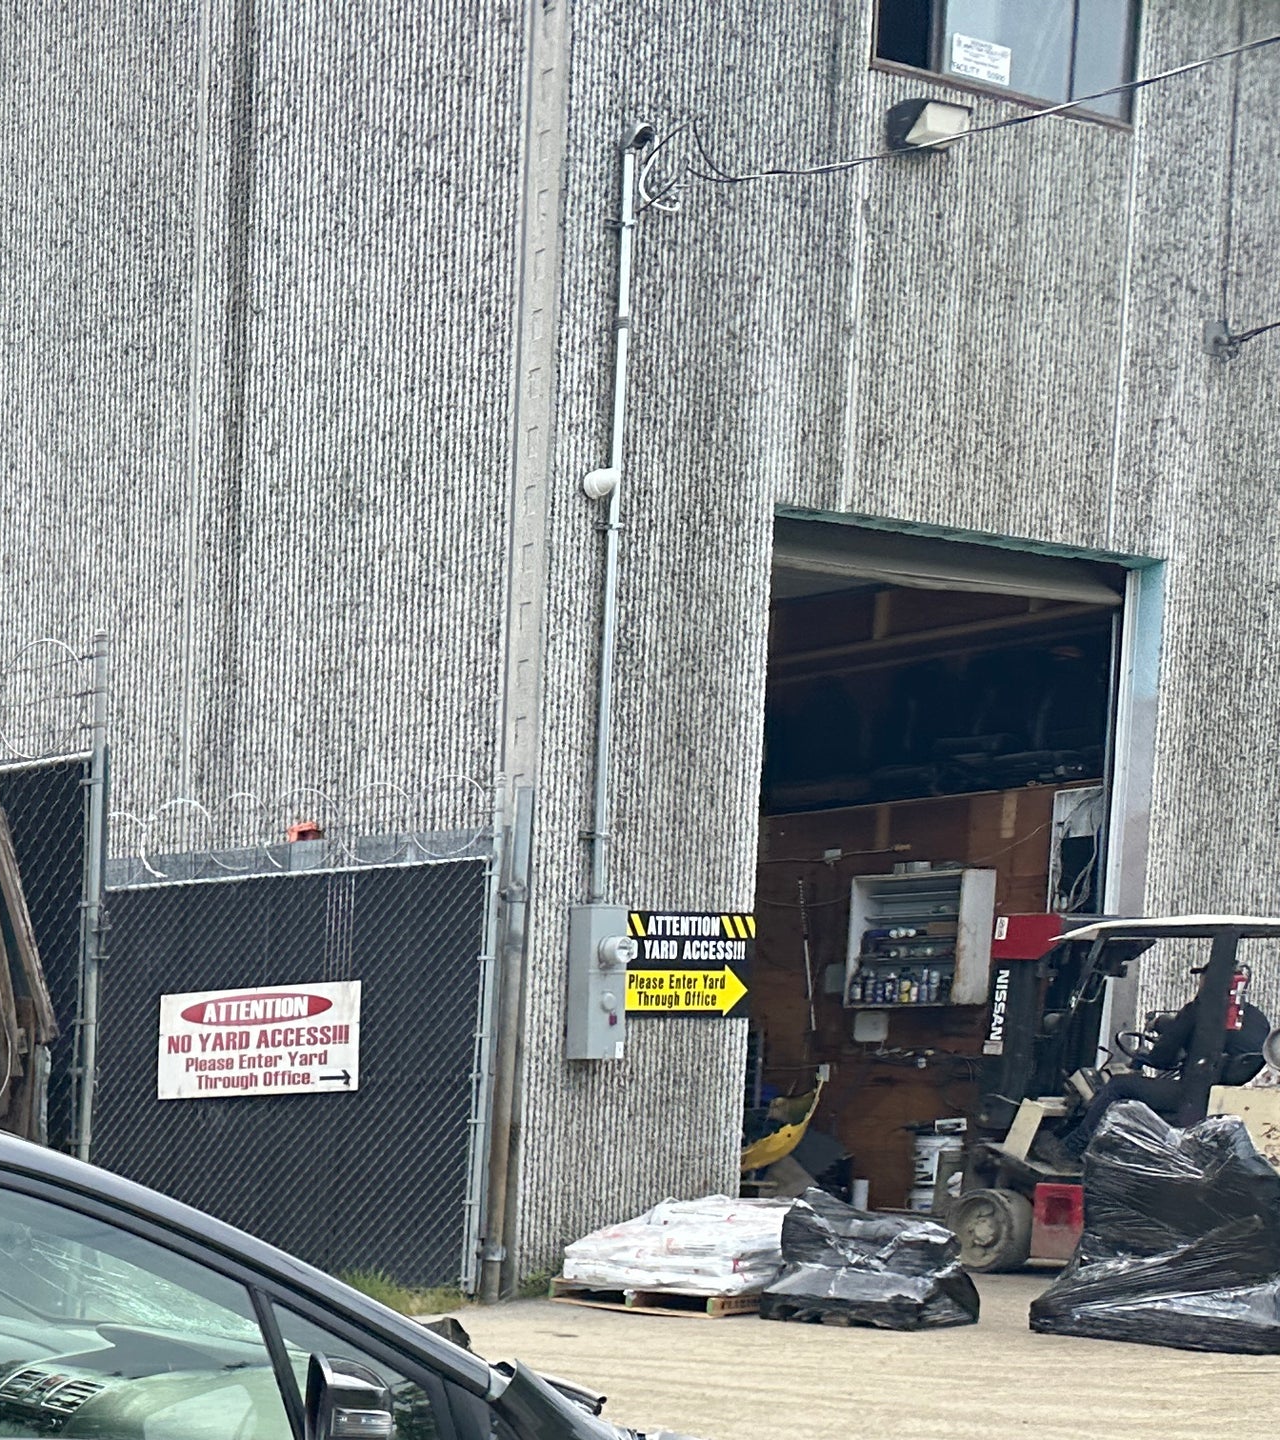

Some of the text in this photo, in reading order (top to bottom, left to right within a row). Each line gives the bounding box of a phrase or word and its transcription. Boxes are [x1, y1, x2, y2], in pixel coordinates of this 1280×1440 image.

[647, 915, 720, 937] ATTENTION
[644, 940, 677, 960] YARD
[682, 941, 745, 960] ACCESS!!!
[628, 974, 726, 990] Please Enter Yard
[202, 996, 309, 1024] ATTENTION
[637, 991, 717, 1009] Through Office
[990, 969, 1010, 1040] NISSAN
[167, 1024, 350, 1054] NO YARD ACCESS!!!
[185, 1050, 328, 1073] Please Enter Yard
[196, 1072, 258, 1090] Through
